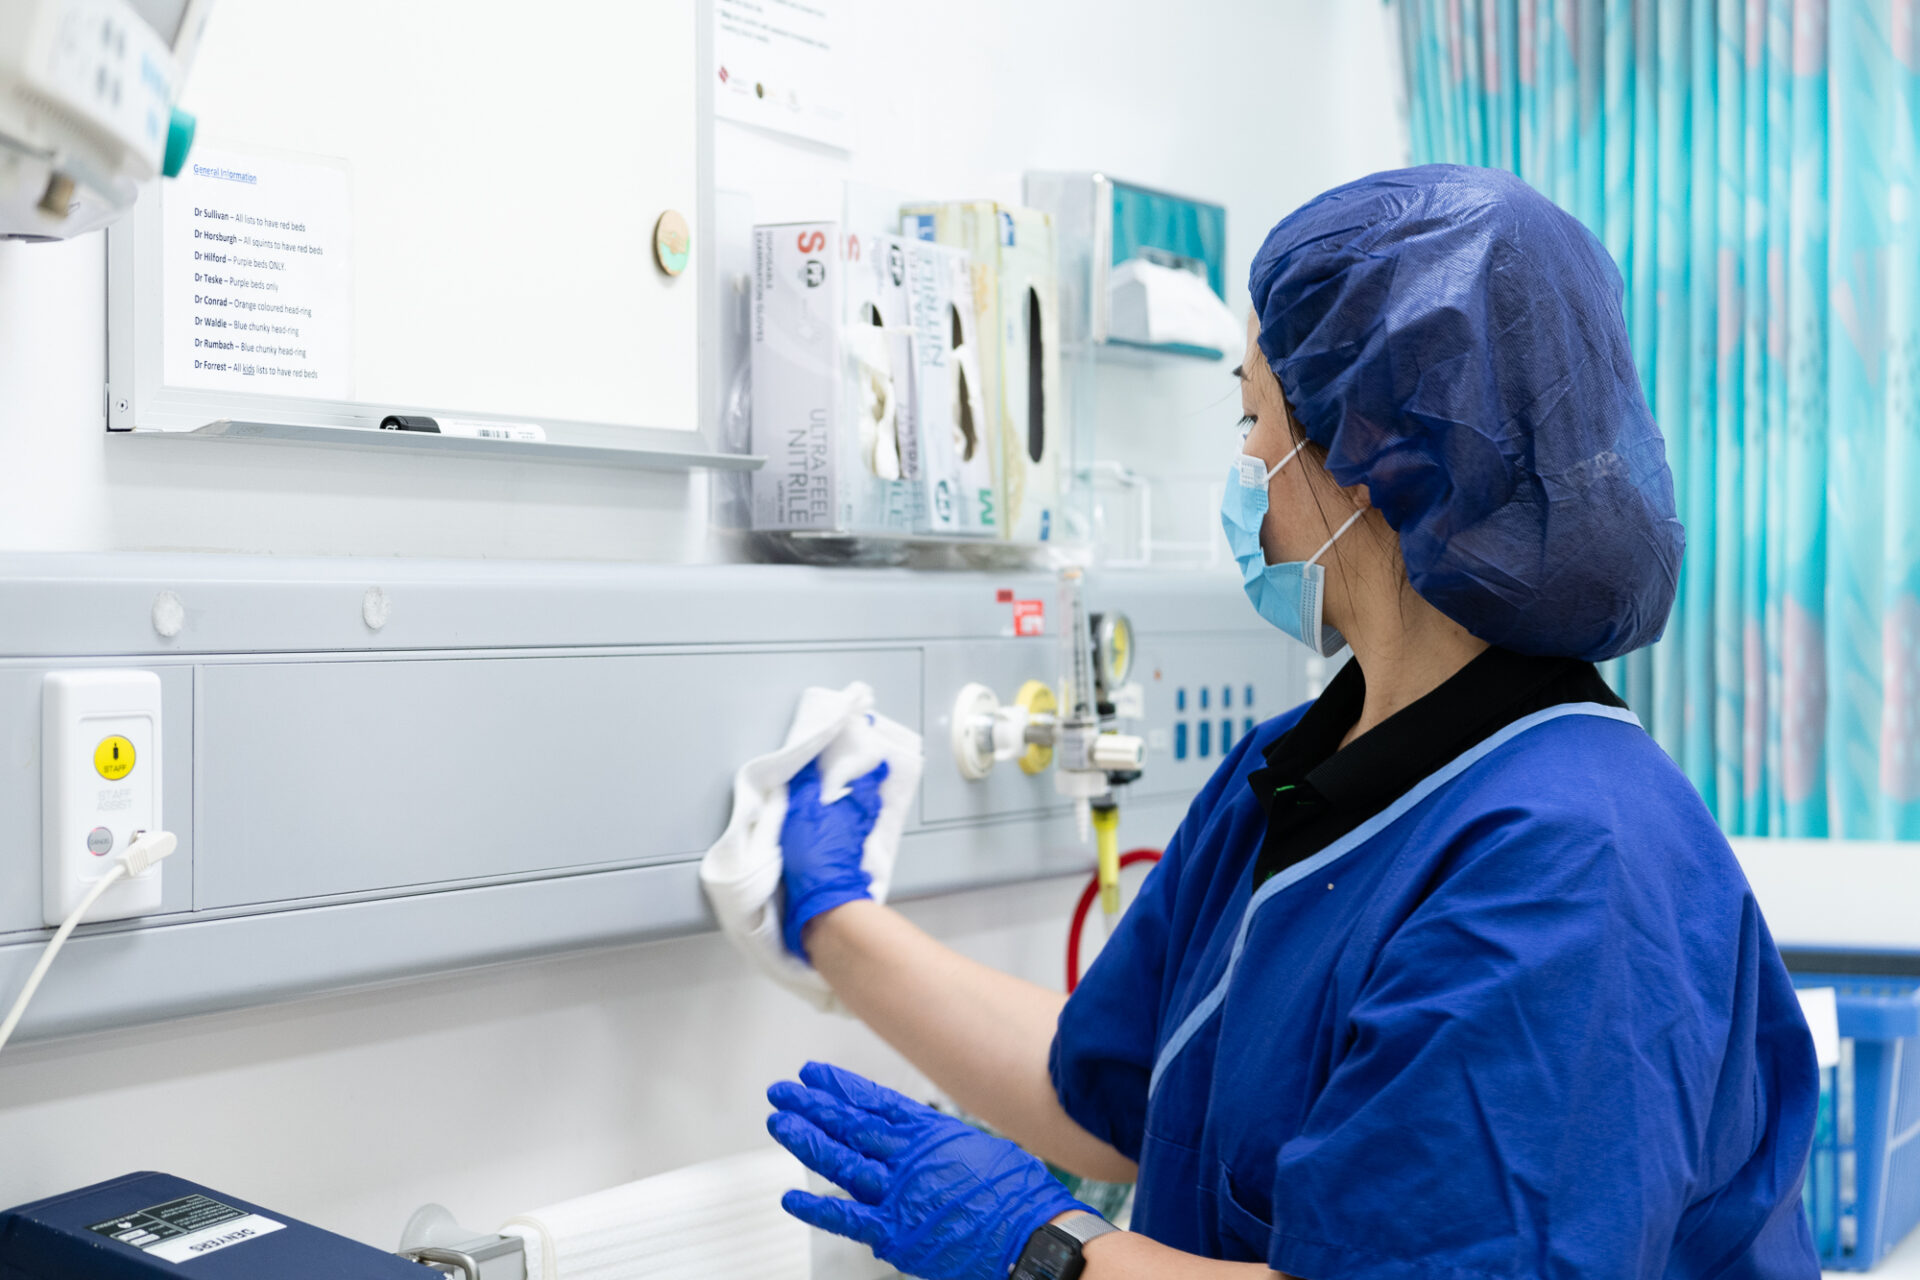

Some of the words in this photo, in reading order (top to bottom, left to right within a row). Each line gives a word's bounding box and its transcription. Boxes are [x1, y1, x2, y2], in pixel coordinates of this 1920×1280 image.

[194, 164, 219, 177] General
[221, 168, 257, 184] Information
[194, 208, 202, 216] Dr
[204, 208, 229, 220] Sullivan
[235, 214, 244, 222] All
[244, 215, 256, 225] lists
[256, 218, 263, 226] to
[265, 218, 278, 228] have
[280, 220, 290, 230] red
[291, 221, 306, 232] beds
[194, 229, 202, 238] Dr
[204, 230, 237, 244] Horsburgh
[252, 238, 273, 250] squints
[274, 241, 281, 250] to
[282, 242, 296, 252] have
[298, 244, 308, 254] red
[309, 246, 323, 256] beds
[798, 230, 826, 254] S
[194, 251, 202, 260] Dr
[204, 252, 226, 264] Hilford
[233, 256, 252, 268] Purple
[254, 258, 268, 269] beds
[194, 272, 202, 282] Dr
[204, 274, 222, 284] Teske
[230, 276, 249, 288] Purple
[251, 280, 264, 290] beds
[266, 282, 279, 292] only
[194, 294, 202, 304] Dr
[204, 296, 228, 306] Conrad
[234, 299, 256, 311] Orange
[258, 301, 284, 312] coloured
[284, 305, 312, 318] head-ring
[194, 316, 202, 326] Dr
[204, 318, 227, 328] Waldie
[234, 320, 248, 330] Blue
[248, 322, 270, 333] chunky
[272, 324, 299, 337] head-ring
[194, 338, 202, 347] Dr
[204, 339, 234, 350] Rumbach
[240, 342, 254, 352] Blue
[256, 344, 276, 355] chunky
[278, 346, 306, 359] head-ring
[194, 360, 202, 369] Dr
[204, 361, 226, 371] Forrest
[234, 363, 242, 372] All
[242, 364, 255, 375] kids
[256, 365, 268, 374] lists
[269, 366, 276, 375] to
[277, 366, 291, 376] have
[292, 368, 302, 378] red
[304, 368, 318, 378] beds
[810, 408, 828, 470] ULTRA
[788, 430, 808, 524] NITRILE
[810, 476, 828, 522] FEEL
[978, 489, 996, 525] M
[104, 764, 127, 774] STAFF
[98, 788, 132, 800] STAFF
[97, 800, 132, 811] ASSIST
[189, 1228, 256, 1252] DENYERS
